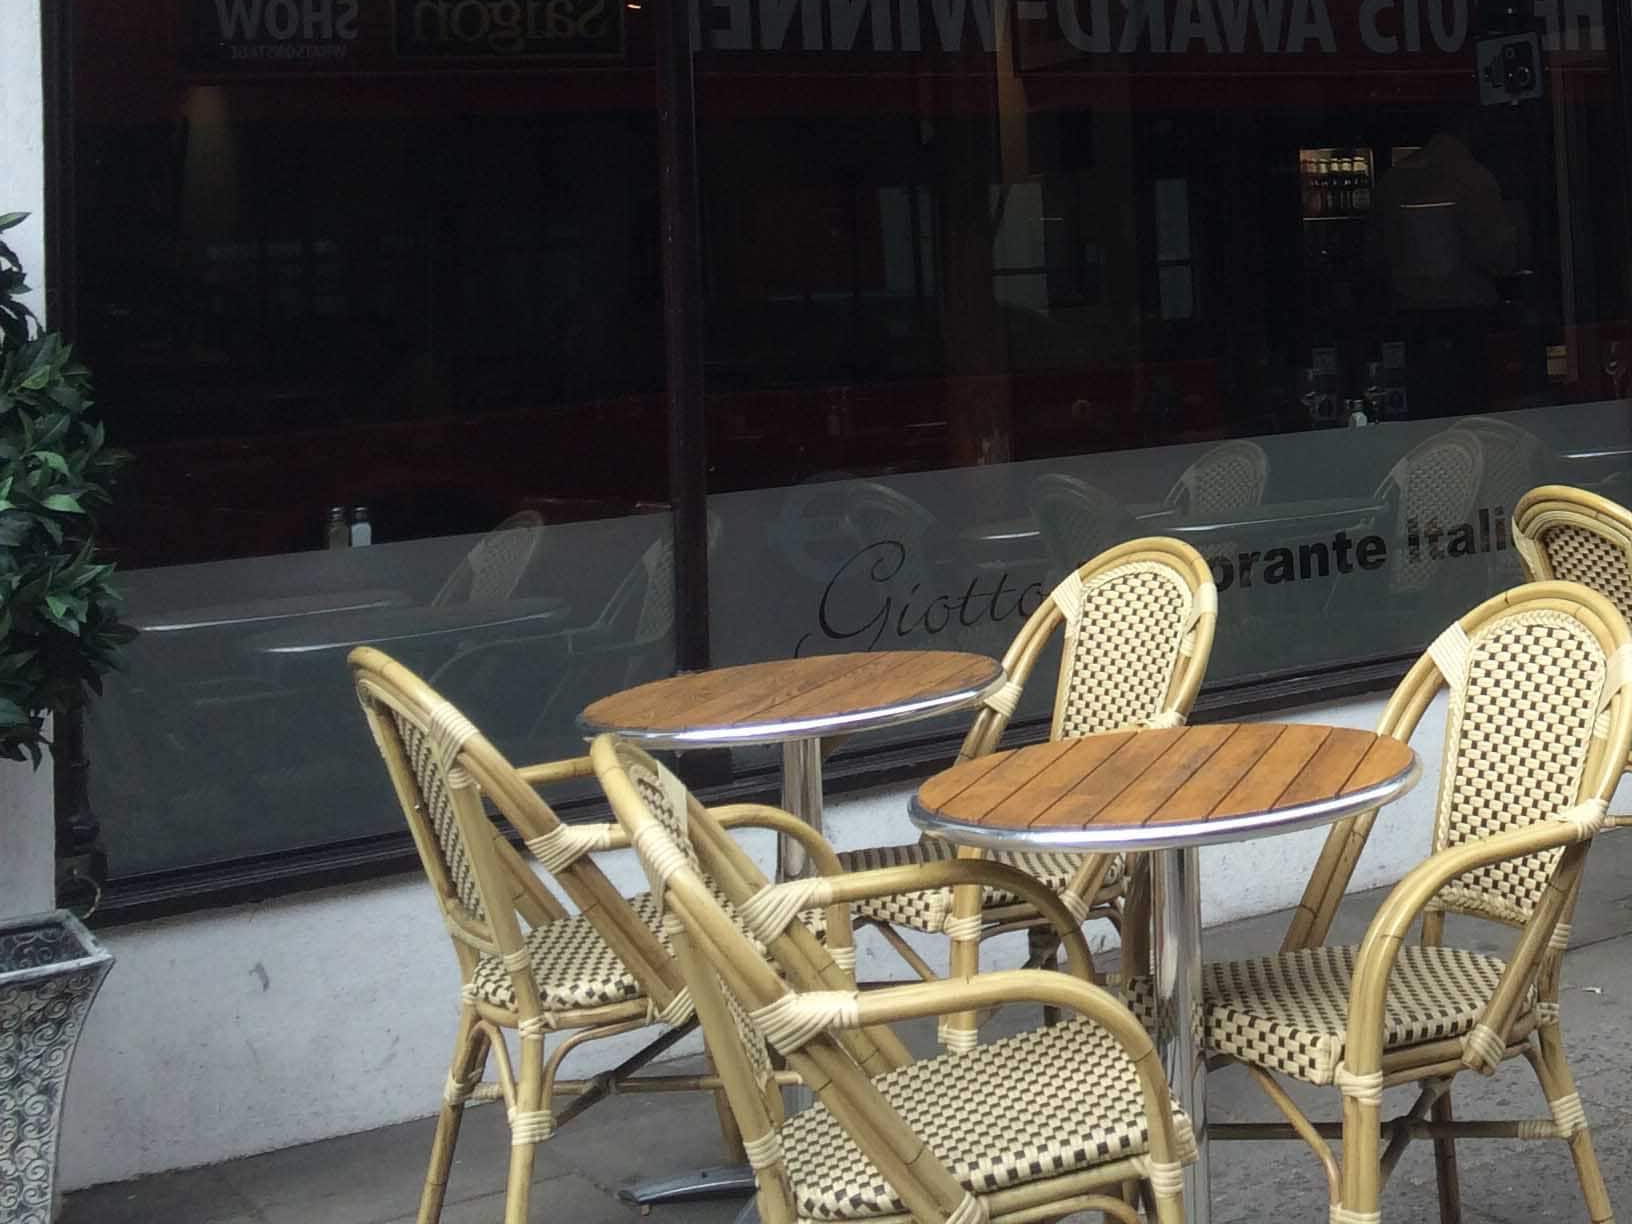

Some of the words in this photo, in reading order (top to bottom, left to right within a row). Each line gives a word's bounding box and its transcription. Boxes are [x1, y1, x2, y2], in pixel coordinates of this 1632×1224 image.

[798, 539, 1048, 658] Giotto
[1206, 531, 1387, 593] orante
[1407, 505, 1508, 564] itali
